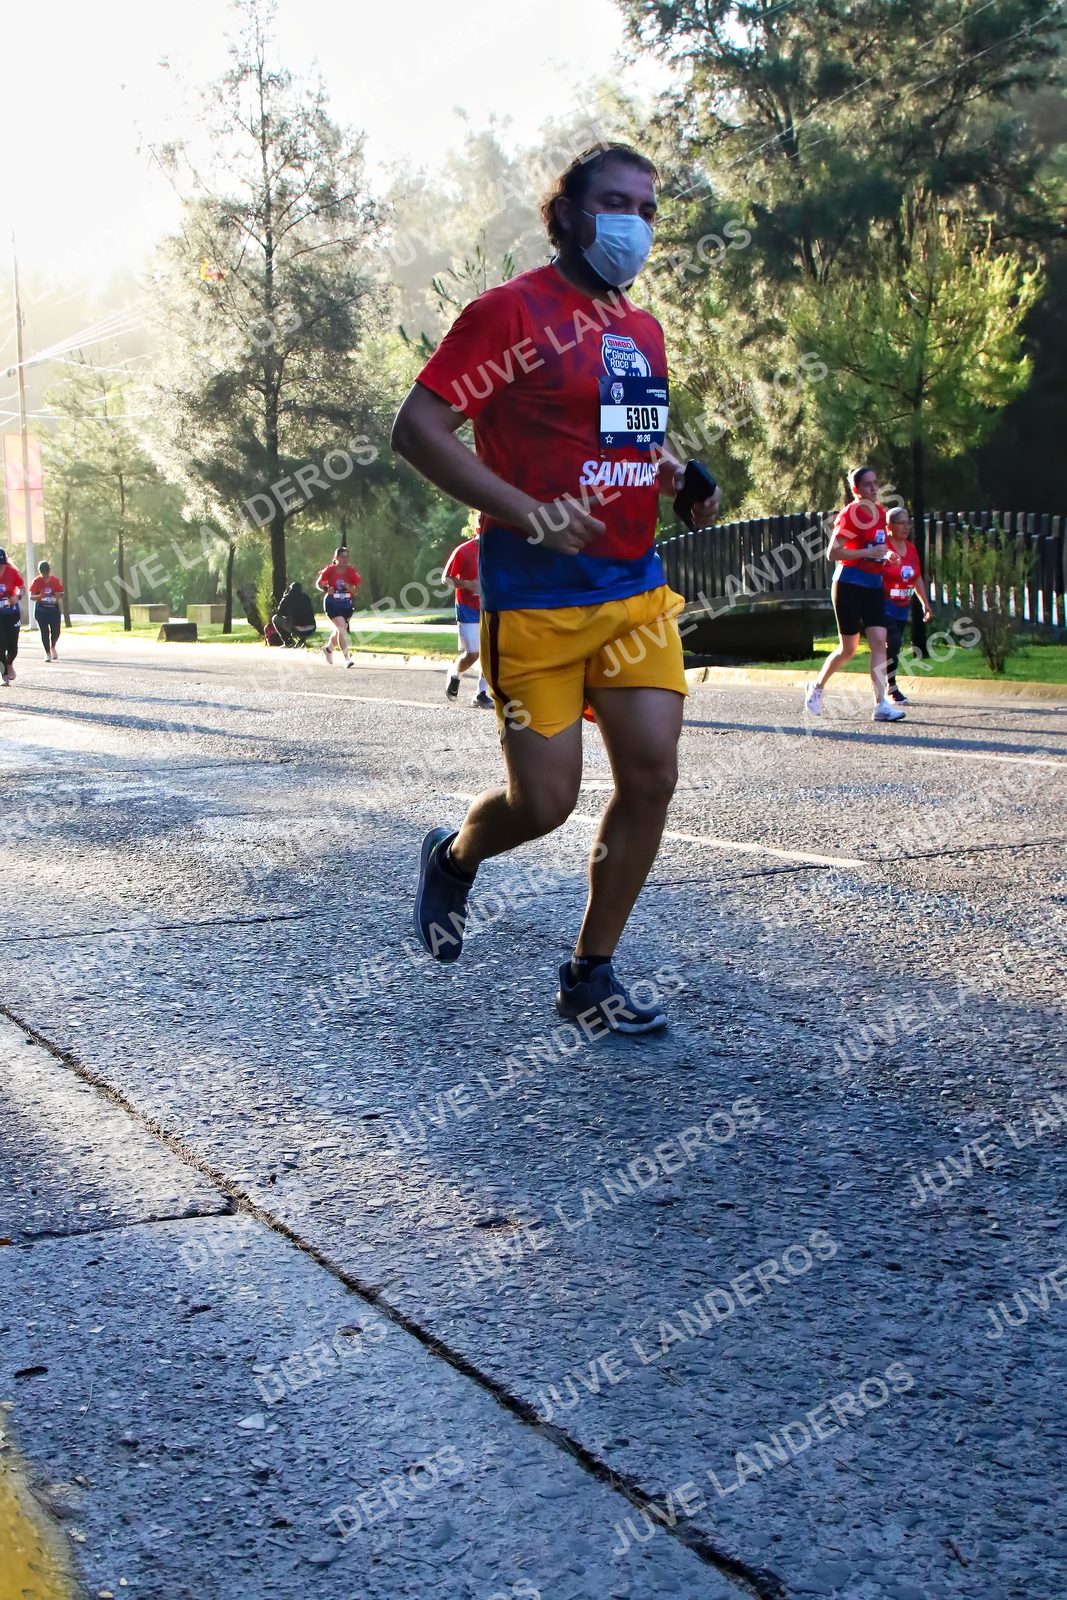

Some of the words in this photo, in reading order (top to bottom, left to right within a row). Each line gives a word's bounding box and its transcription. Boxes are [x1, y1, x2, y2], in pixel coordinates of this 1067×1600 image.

[605, 338, 633, 349] BIMBO
[611, 349, 636, 362] Global
[610, 358, 630, 369] Race
[626, 406, 660, 430] 5309
